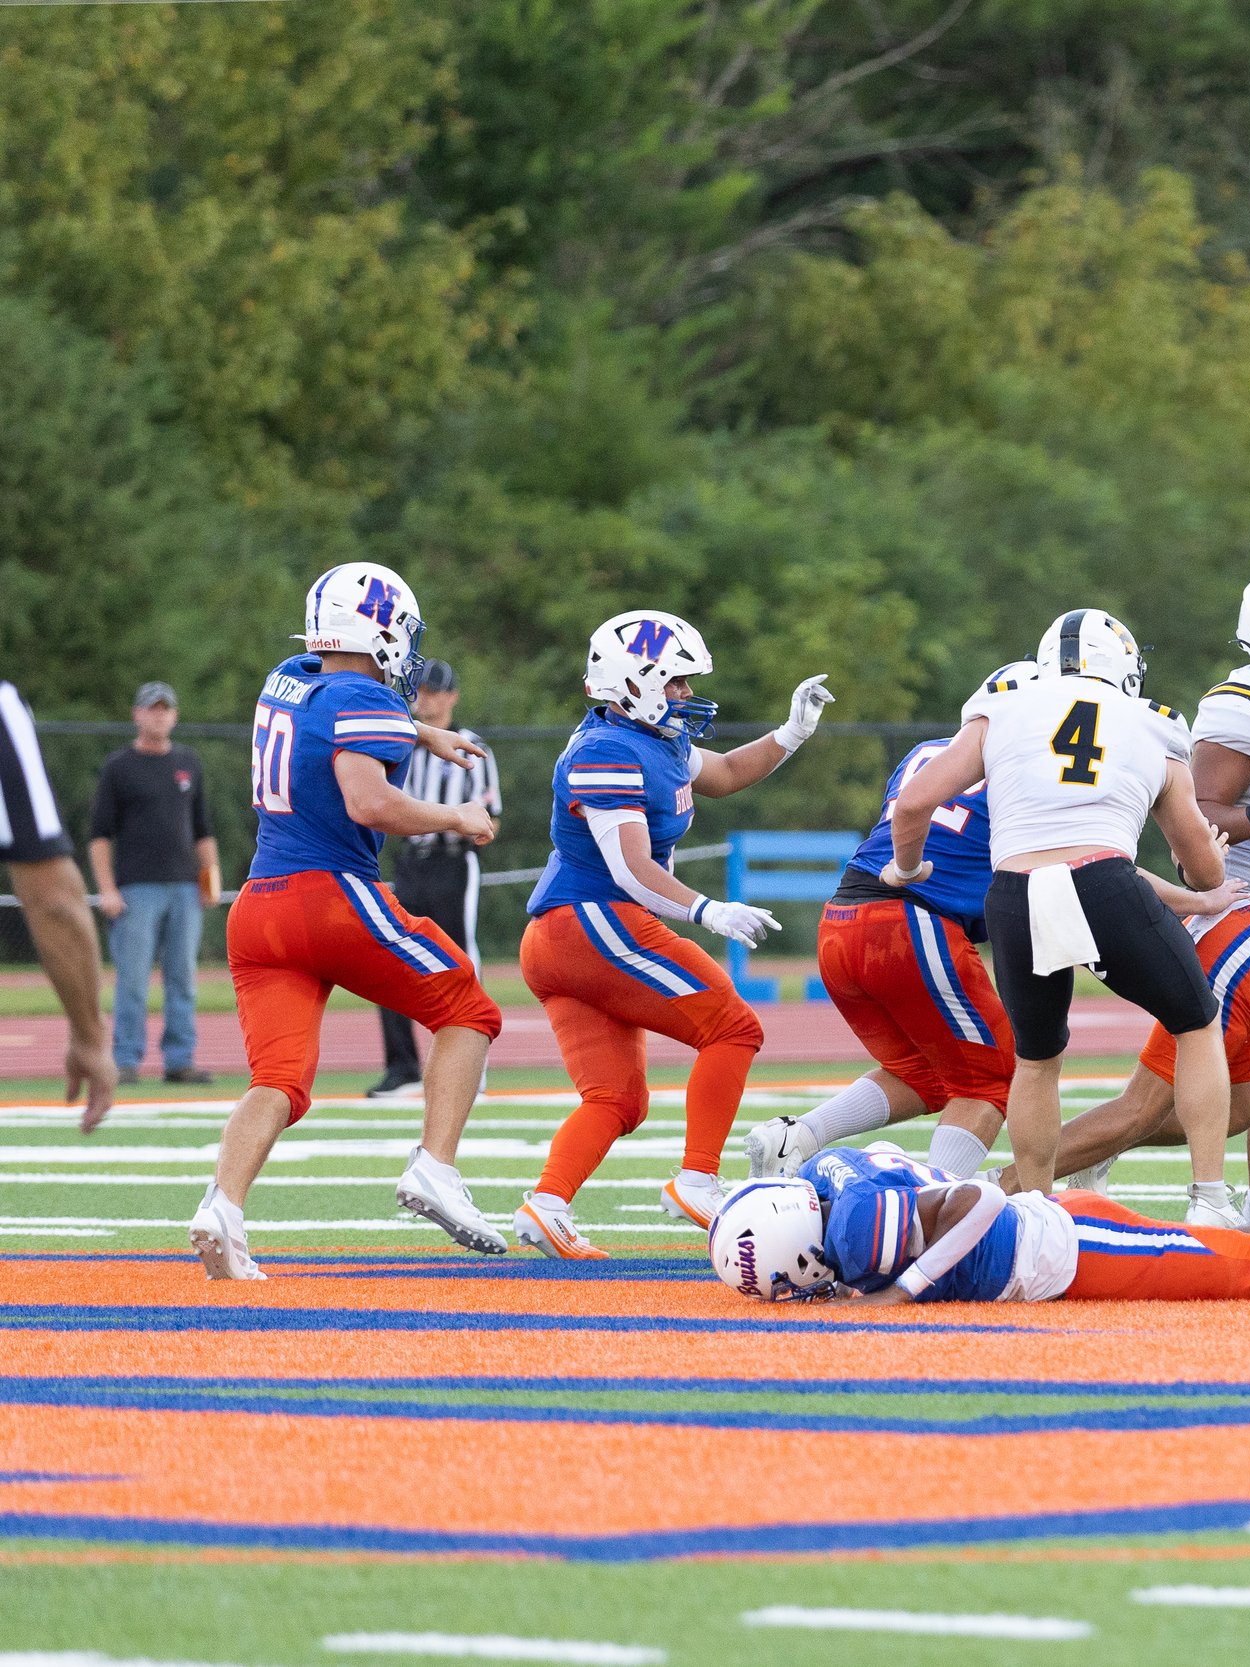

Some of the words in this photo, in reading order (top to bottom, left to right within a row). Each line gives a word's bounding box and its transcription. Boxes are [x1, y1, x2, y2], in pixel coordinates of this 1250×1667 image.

[355, 576, 402, 630] N
[625, 619, 675, 665] N
[251, 701, 295, 815] 50
[1049, 699, 1106, 787] 4
[733, 1239, 764, 1297] Bruins
